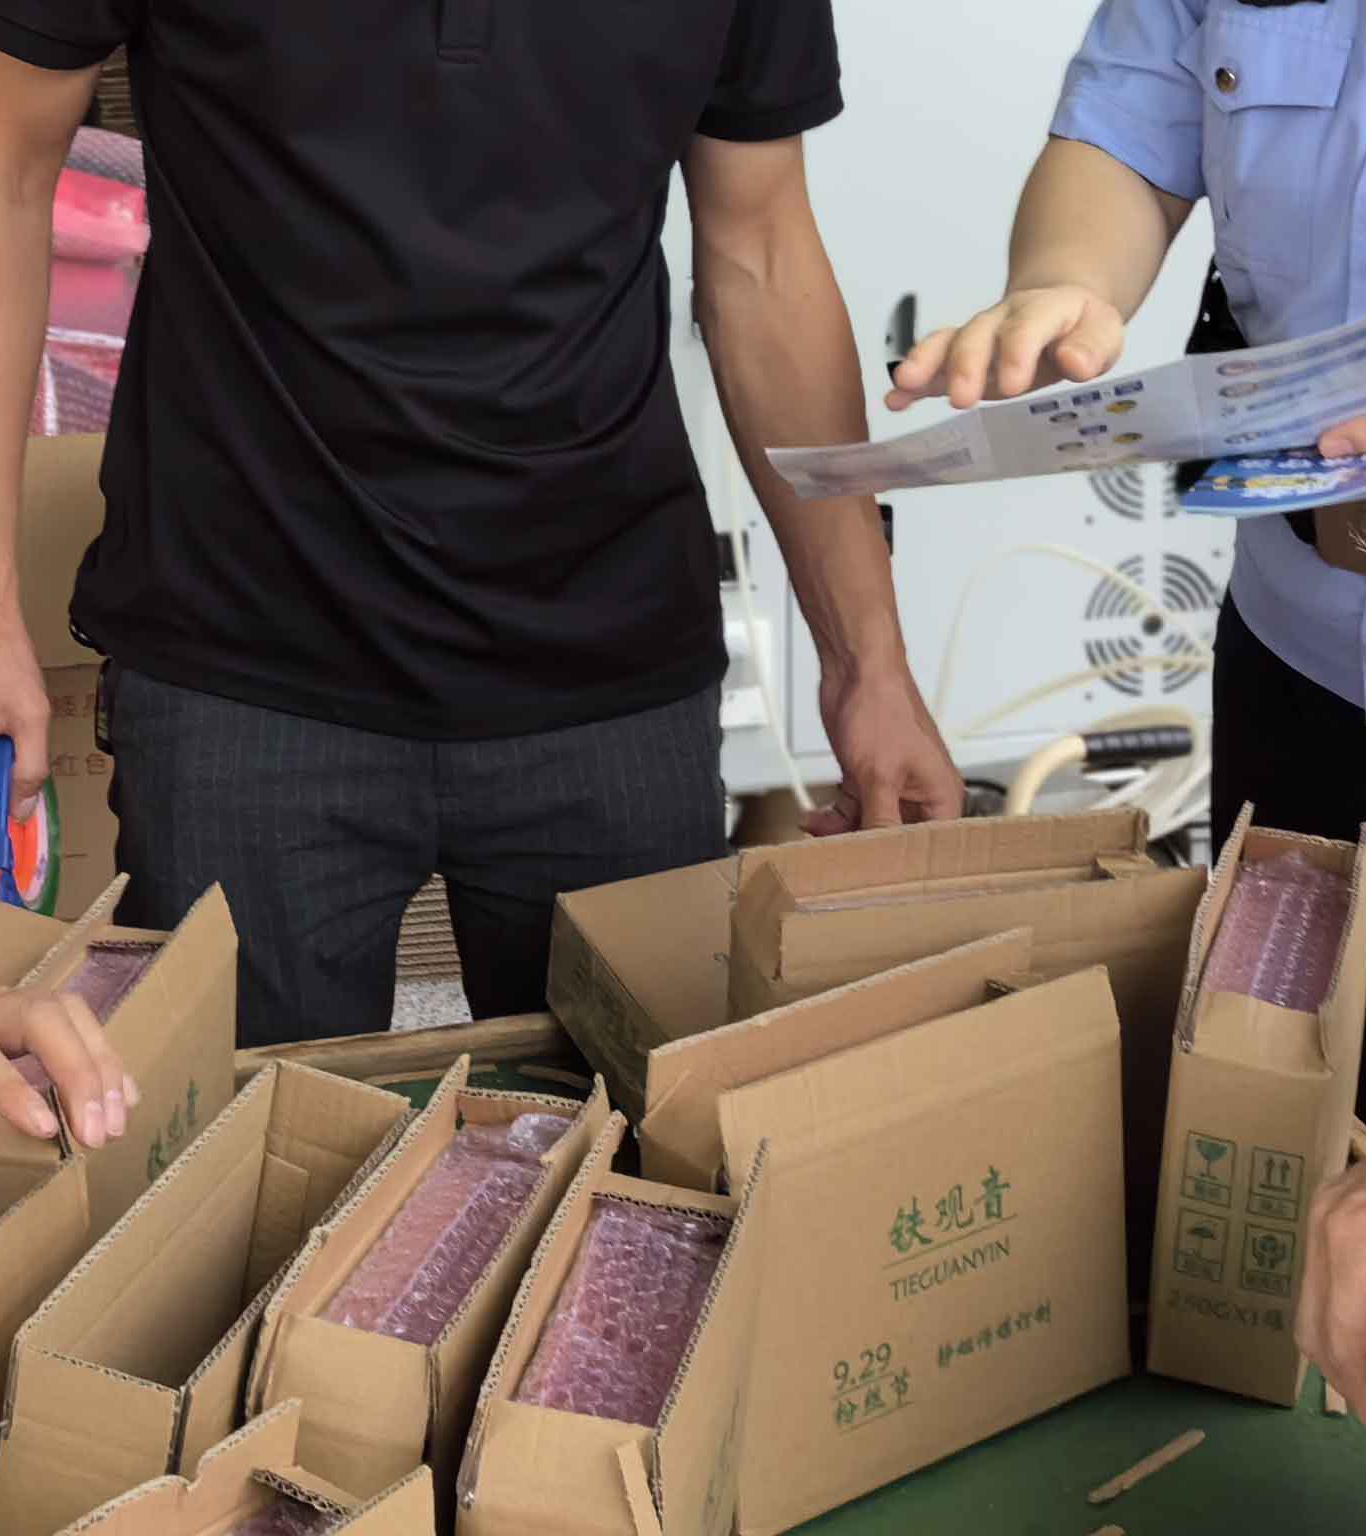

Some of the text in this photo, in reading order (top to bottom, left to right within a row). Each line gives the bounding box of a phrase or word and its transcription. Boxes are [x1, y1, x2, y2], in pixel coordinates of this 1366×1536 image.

[889, 1164, 1011, 1254] 铁观音
[889, 1235, 1012, 1302] TIEGUANYIN
[833, 1342, 892, 1392] 9.29
